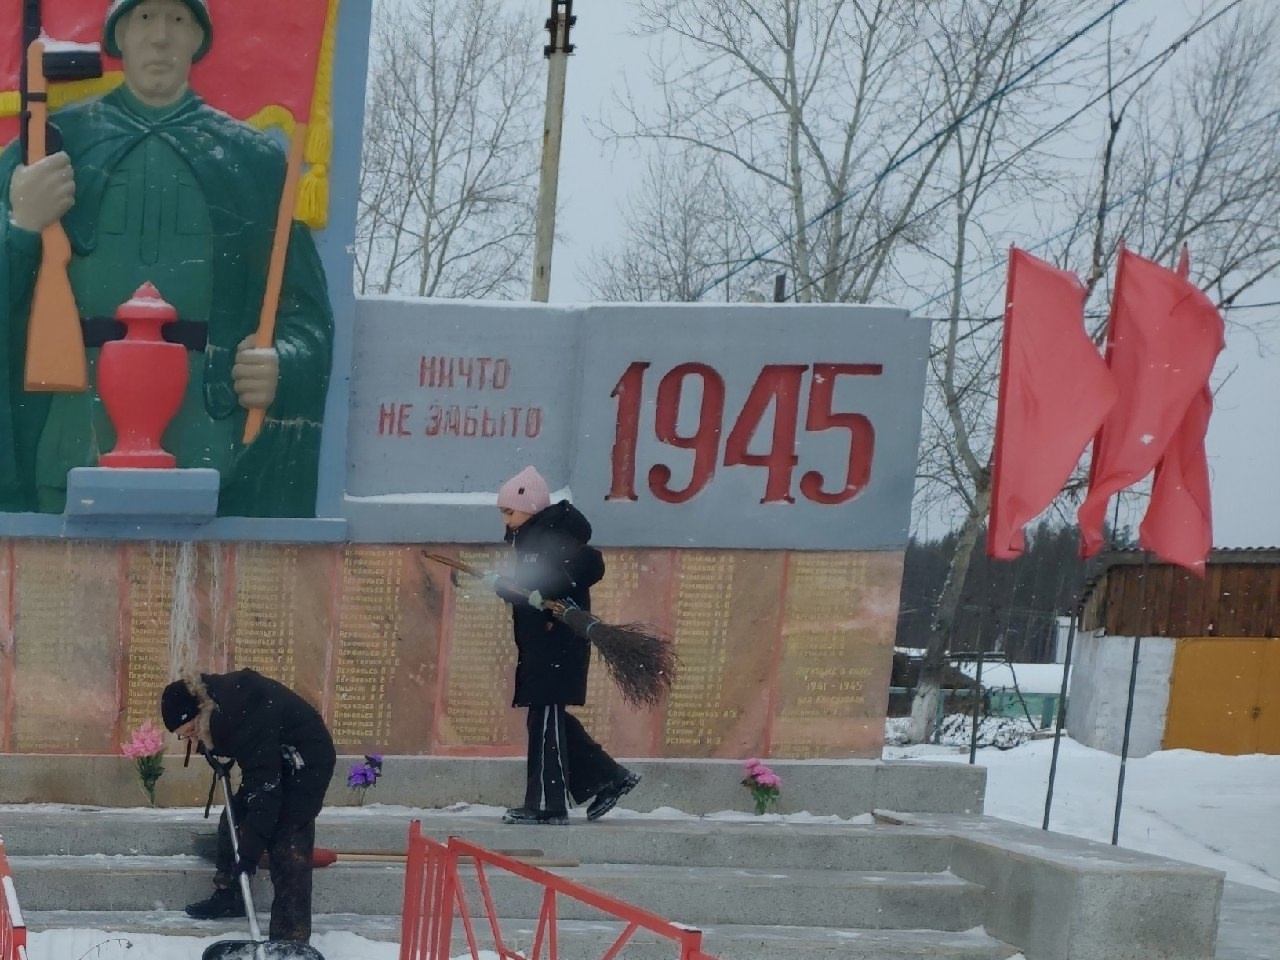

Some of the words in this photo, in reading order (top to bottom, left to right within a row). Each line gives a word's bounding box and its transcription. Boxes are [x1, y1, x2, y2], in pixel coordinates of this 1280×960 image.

[418, 354, 512, 391] НИЧТО
[378, 402, 411, 438] НЕ
[424, 404, 542, 439] ЗАБЫТО
[604, 361, 883, 504] 1945
